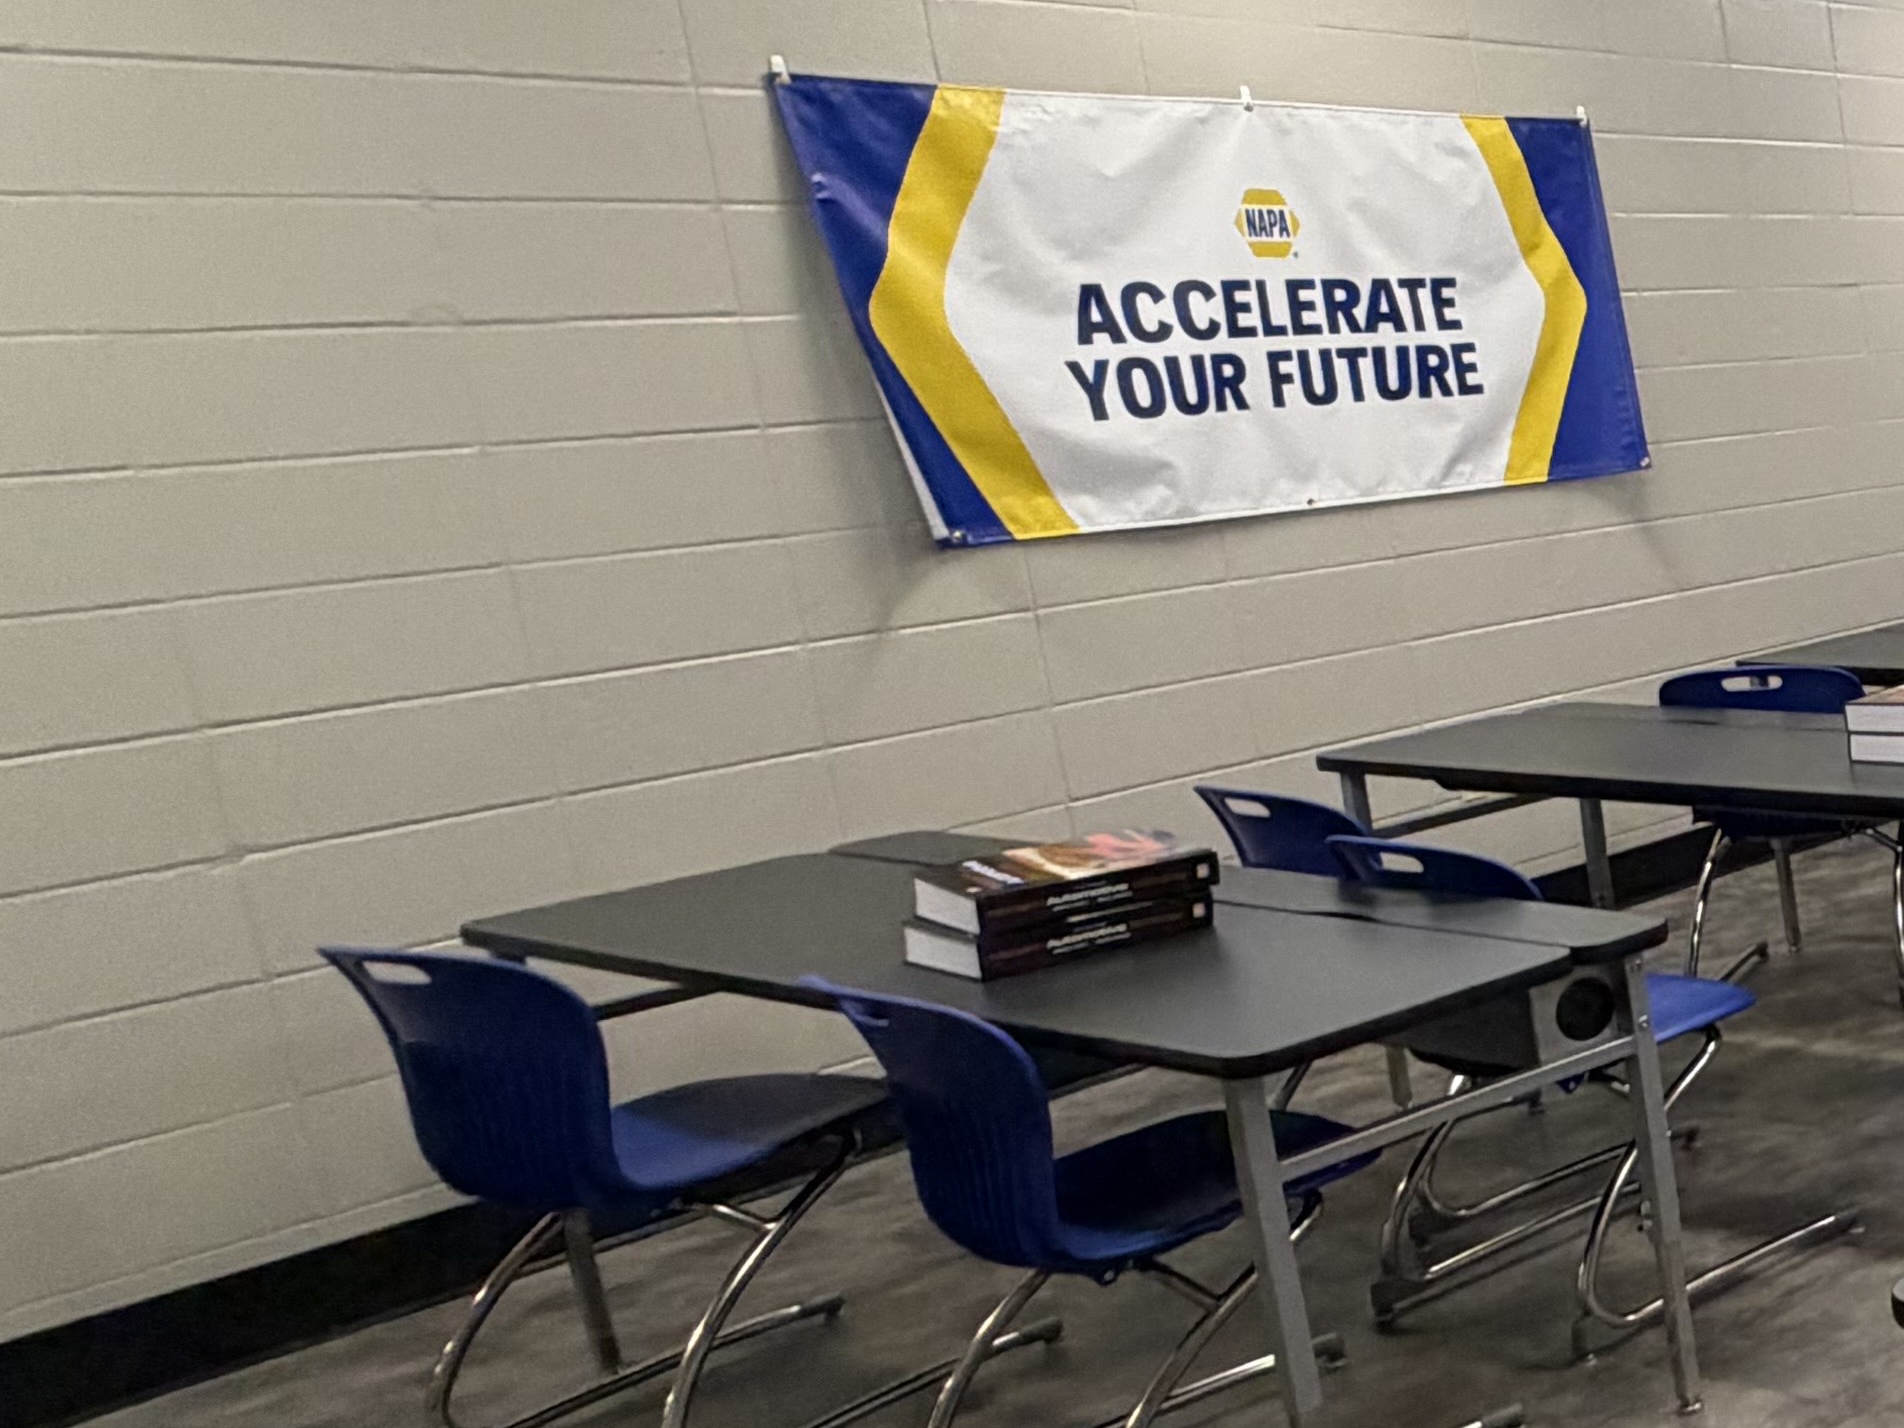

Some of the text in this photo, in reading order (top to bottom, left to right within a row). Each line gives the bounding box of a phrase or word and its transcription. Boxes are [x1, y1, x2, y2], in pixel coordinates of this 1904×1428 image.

[1244, 208, 1291, 239] NAPA
[1077, 276, 1463, 346] ACCELERATE
[1064, 342, 1485, 422] YOUR FUTURE
